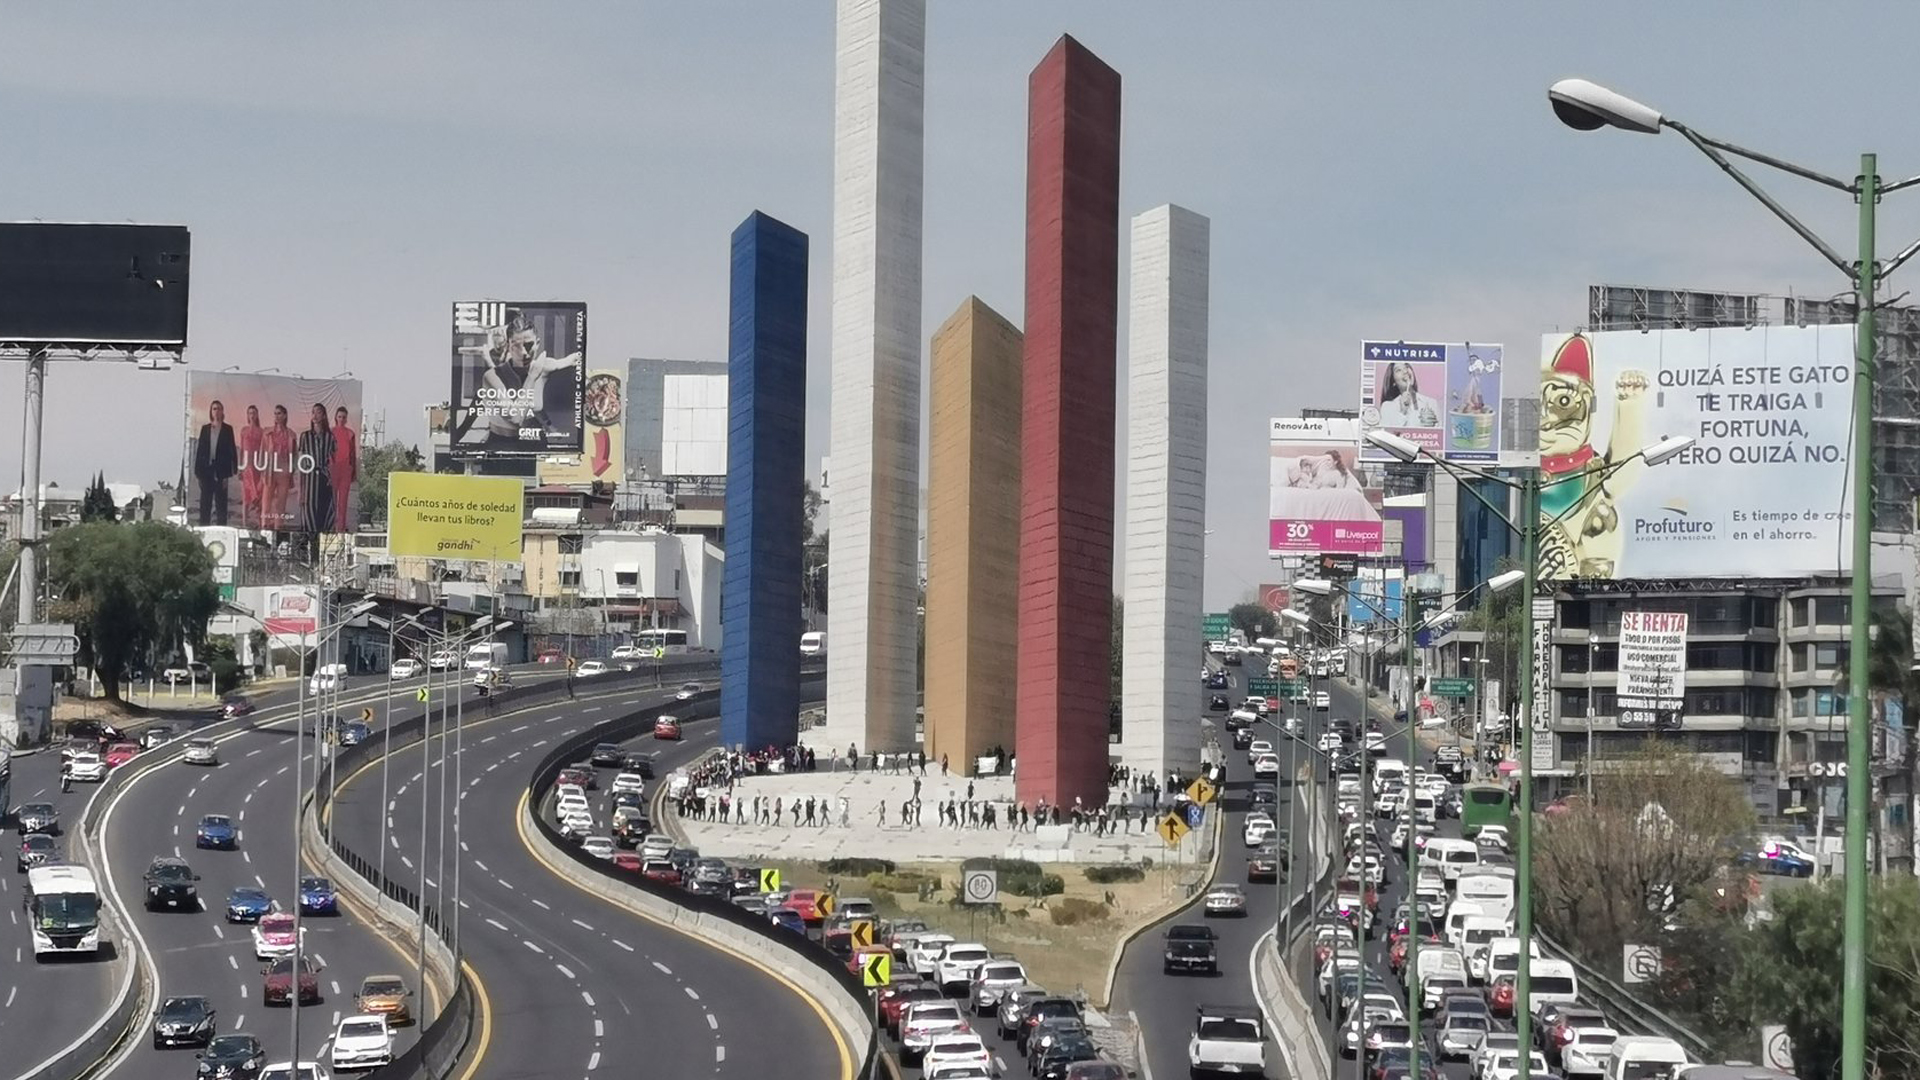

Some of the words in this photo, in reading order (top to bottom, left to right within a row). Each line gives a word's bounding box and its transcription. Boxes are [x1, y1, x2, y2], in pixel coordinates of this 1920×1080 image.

[576, 311, 584, 342] FUERZA
[1385, 348, 1438, 358] NUTRISA
[1657, 364, 1725, 387] QUIZÁ
[1732, 367, 1782, 385] ESTE
[1788, 365, 1849, 384] GATO
[477, 388, 534, 399] CONOCE
[574, 391, 582, 428] ATHLETIC
[1696, 394, 1721, 412] TE
[1727, 393, 1808, 411] TRAIGA
[468, 407, 535, 418] PERFECTA
[518, 428, 542, 437] GRIT
[1274, 422, 1323, 430] RenovArte
[1701, 419, 1809, 439] FORTUNA,
[1666, 446, 1722, 465] ERO
[1729, 441, 1797, 464] QUIZÁ
[1805, 445, 1845, 463] NO.
[237, 451, 315, 474] JULIO
[396, 497, 439, 508] ¿Cuántos
[442, 499, 464, 510] años
[466, 501, 478, 511] de
[480, 502, 516, 513] soledad
[417, 512, 445, 523] llevan
[448, 515, 462, 524] tus
[465, 515, 495, 526] libros?
[1733, 510, 1748, 522] Es
[1752, 509, 1797, 524] tiempo
[1803, 509, 1819, 521] de
[1635, 517, 1713, 534] Profuturo
[1346, 531, 1379, 540] Liverpool
[1733, 531, 1748, 540] en
[1753, 528, 1765, 540] el
[437, 540, 474, 551] gandhi
[1623, 613, 1639, 631] SE
[1643, 613, 1685, 632] RENTA
[1648, 635, 1661, 644] POR
[1662, 635, 1681, 644] PISOS
[1627, 652, 1640, 661] USO
[1641, 653, 1677, 663] COMERCIAL
